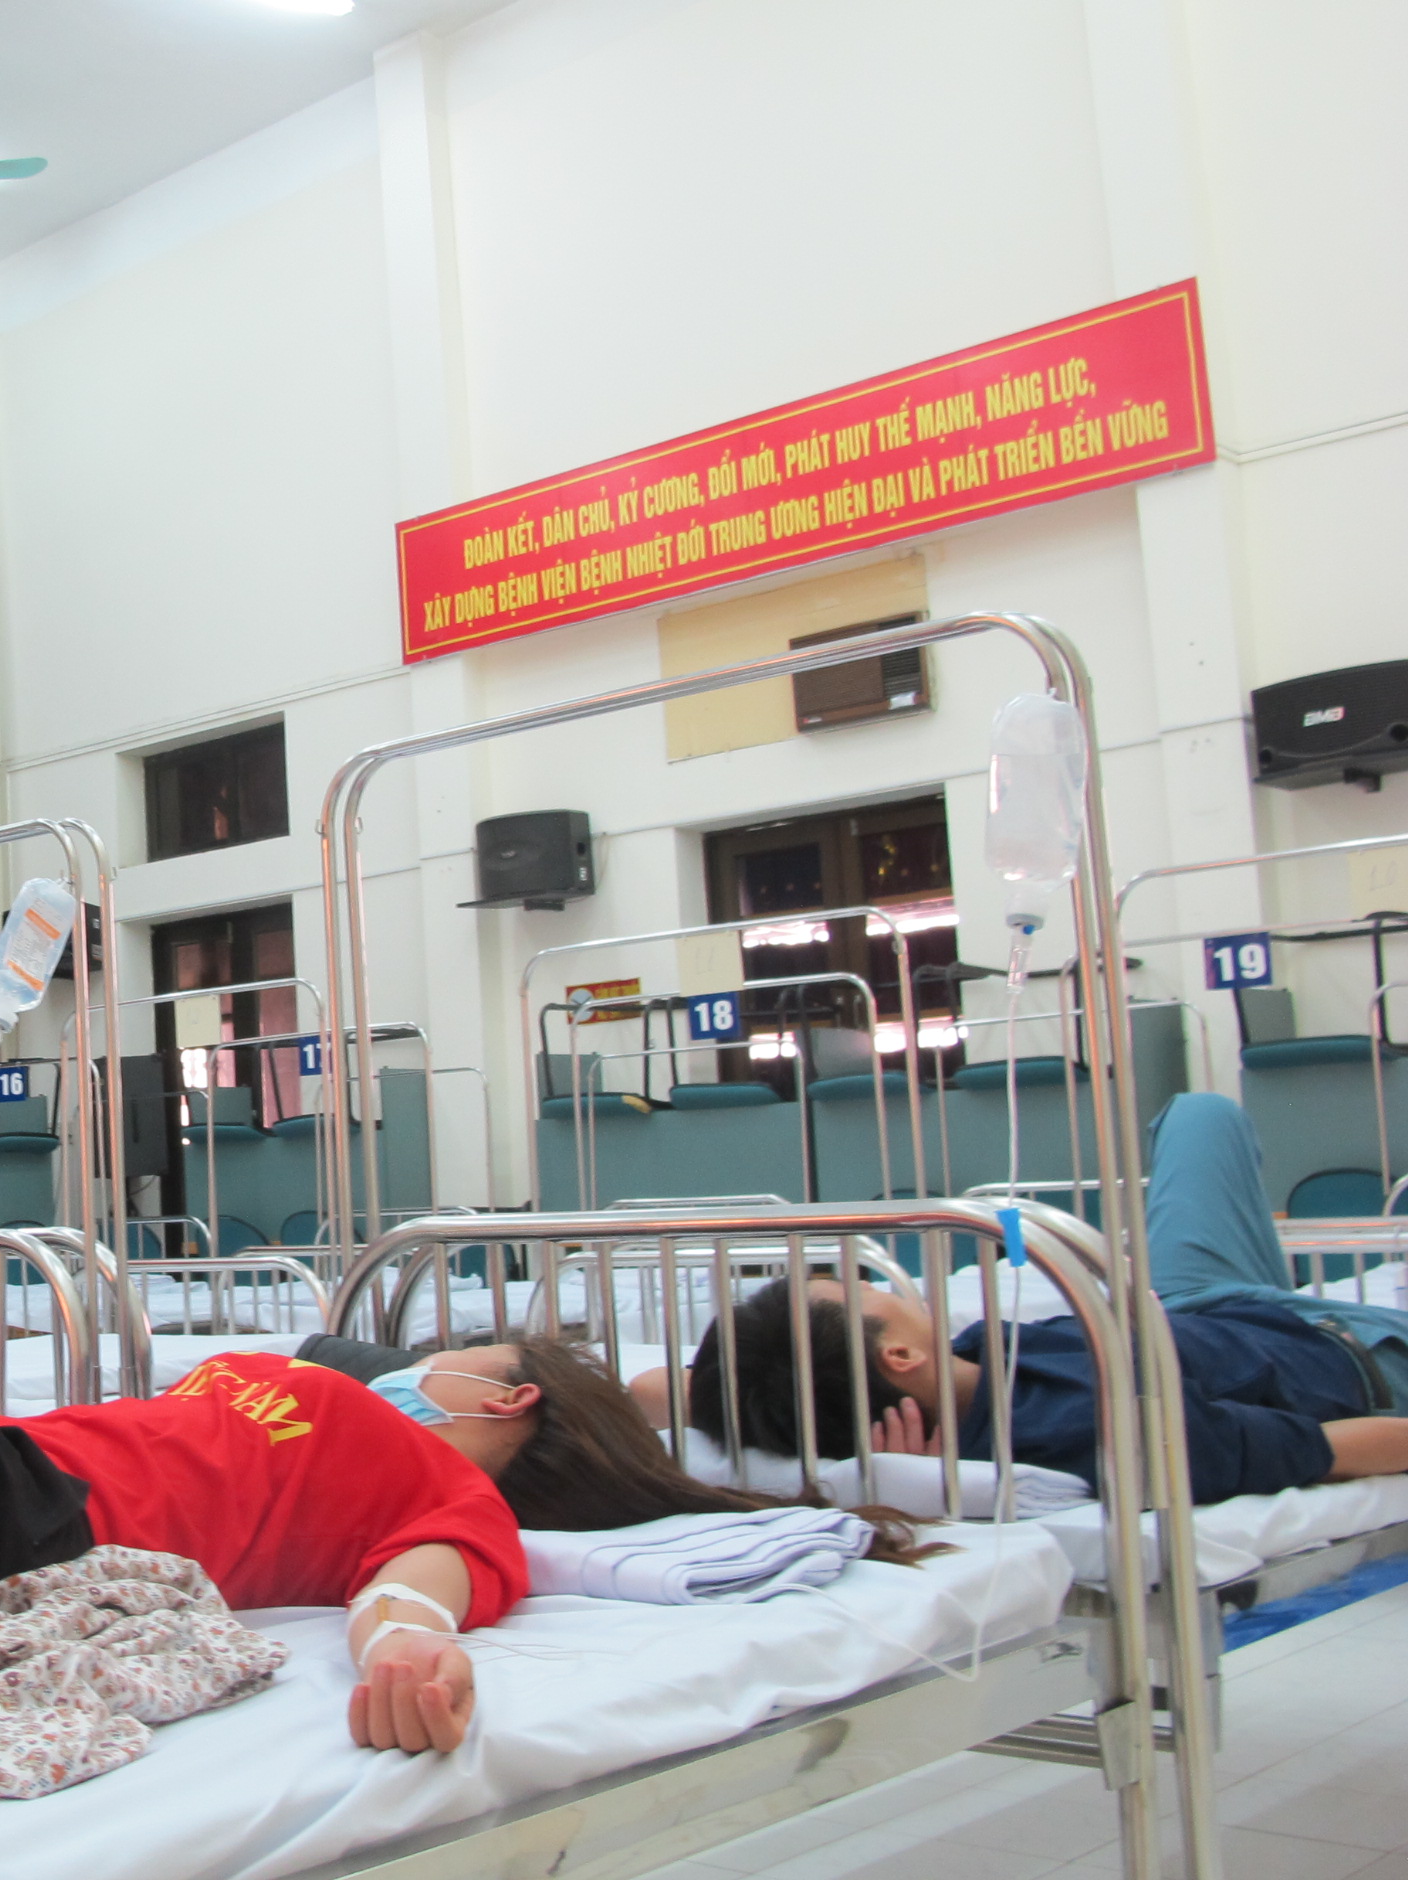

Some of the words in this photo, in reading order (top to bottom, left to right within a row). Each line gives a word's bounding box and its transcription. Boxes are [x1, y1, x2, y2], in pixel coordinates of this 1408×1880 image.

[463, 524, 505, 570] ĐOÀN
[507, 511, 539, 558] KẾT,
[542, 506, 575, 548] DÂN
[578, 485, 615, 539] CHỦ,
[643, 471, 705, 519] CƯƠNG,
[708, 449, 738, 500] ĐỔI
[742, 442, 782, 492] MỚI,
[785, 429, 830, 479] PHÁT
[836, 421, 875, 465] HUY
[876, 396, 912, 453] THẾ
[916, 390, 982, 445] MẠNH,
[985, 371, 1044, 421] NĂNG
[1049, 357, 1096, 408] LỰC,
[423, 590, 451, 632] XÂY
[455, 581, 495, 628] DỰNG
[497, 572, 538, 617] BỆNH
[541, 559, 577, 605] VIỆN
[580, 549, 623, 596] BỆNH
[626, 533, 672, 578] NHIỆT
[677, 519, 706, 566] ĐỚI
[709, 510, 767, 558] TRUNG
[771, 493, 820, 541] ƯƠNG
[823, 479, 868, 529] HIỆN
[871, 470, 905, 517] ĐẠI
[908, 457, 936, 504] VÀ
[939, 445, 990, 496] PHÁT
[994, 419, 1056, 483] TRIỂN
[1058, 407, 1105, 465] BỀN
[1107, 398, 1170, 450] VỮNG
[1213, 943, 1268, 982] 19
[694, 1000, 734, 1032] 18
[0, 1072, 23, 1096] 16
